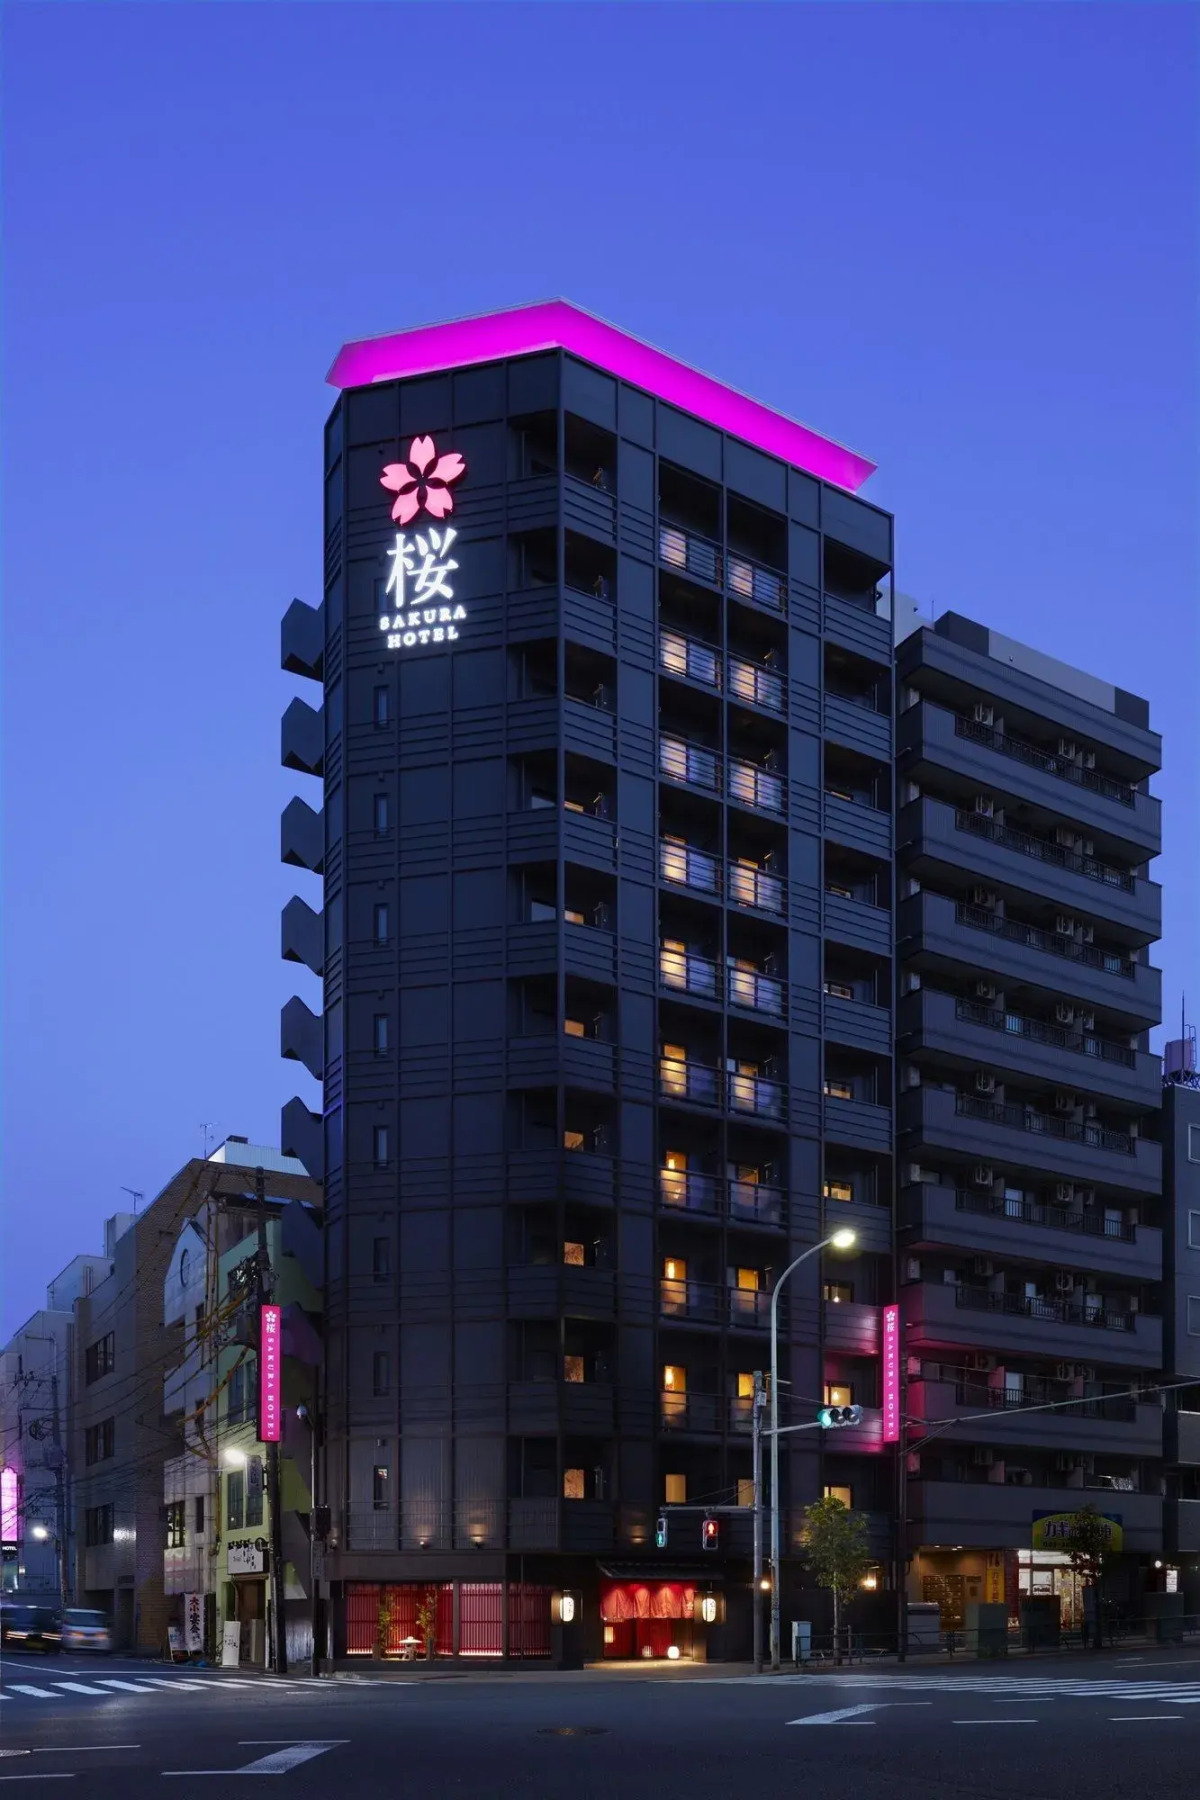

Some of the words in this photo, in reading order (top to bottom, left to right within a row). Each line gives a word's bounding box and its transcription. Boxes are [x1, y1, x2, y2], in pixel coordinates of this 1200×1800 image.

[386, 528, 459, 608] 桜
[379, 605, 467, 631] SAKURA
[387, 626, 459, 649] HOTEL
[267, 1338, 275, 1388] SAKURA
[267, 1395, 275, 1437] HOTEL
